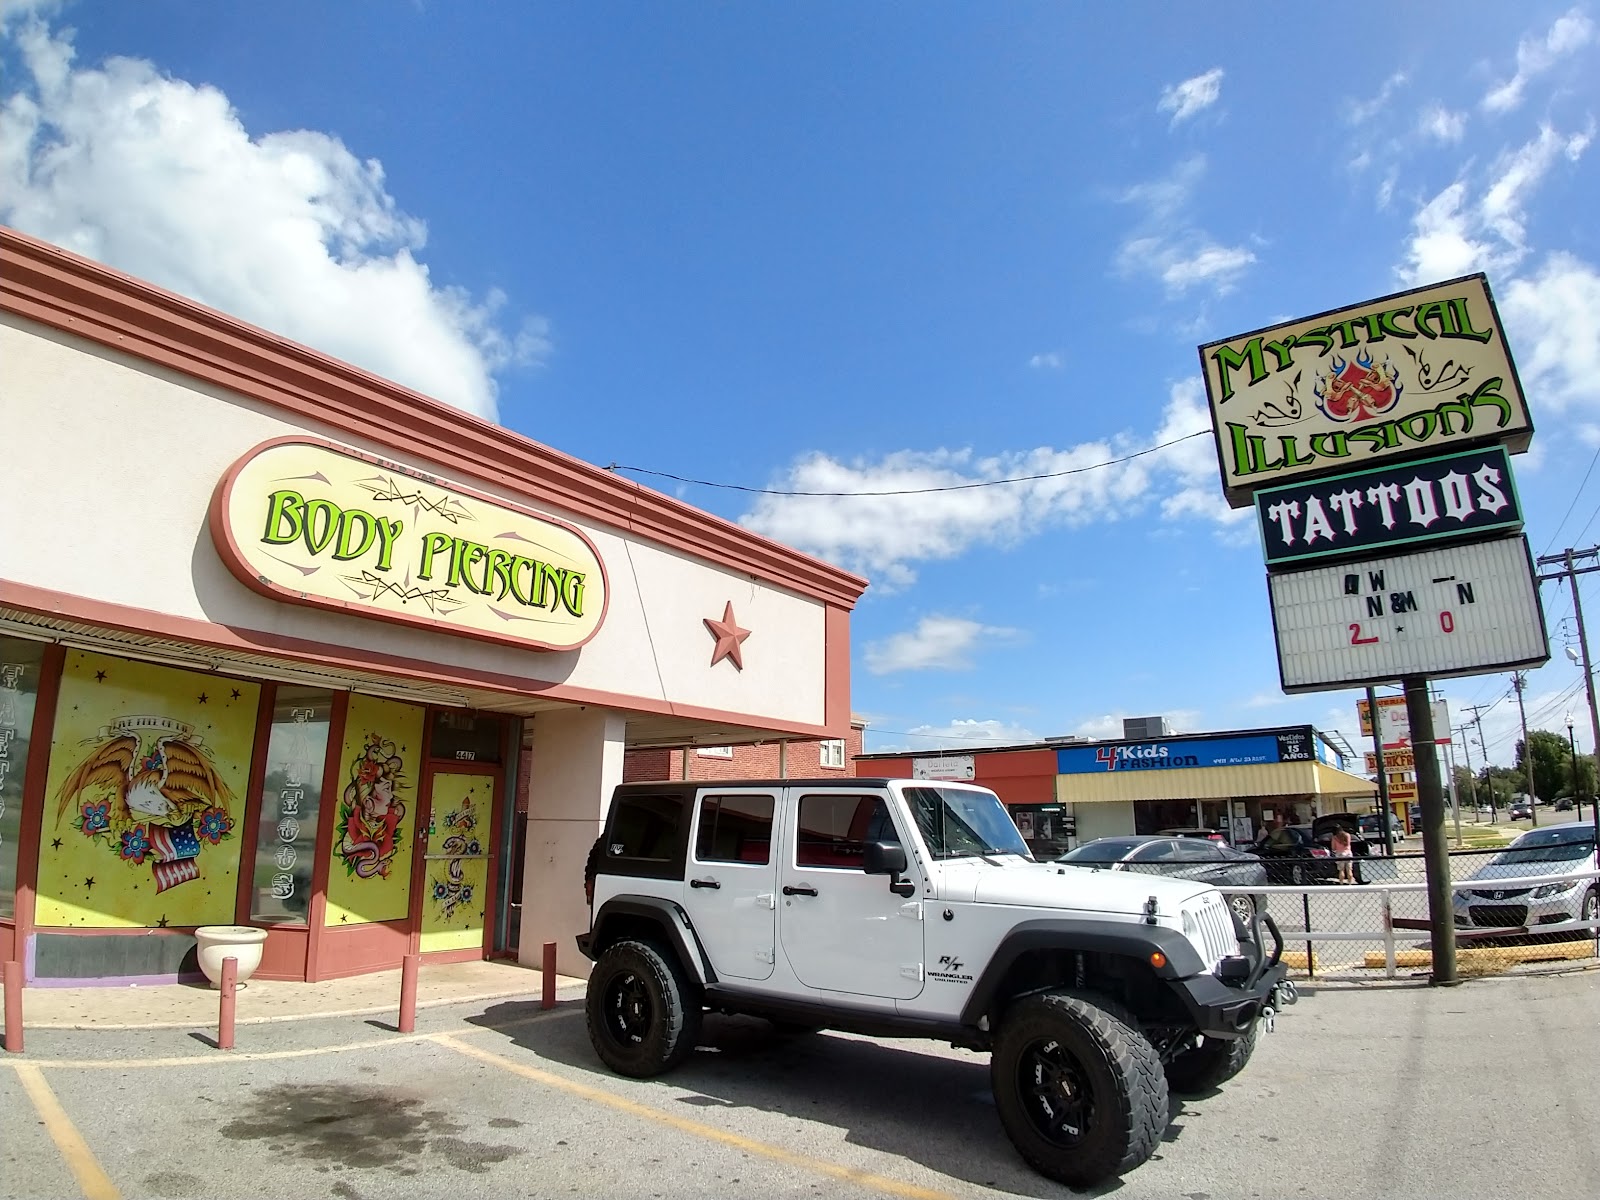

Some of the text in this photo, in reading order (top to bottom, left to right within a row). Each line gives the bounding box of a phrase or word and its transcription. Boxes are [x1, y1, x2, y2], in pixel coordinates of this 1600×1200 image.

[1212, 297, 1492, 404] MYSTICAL
[1225, 377, 1511, 476] ILLUSIONS
[1267, 462, 1509, 546] TATTOOS
[261, 490, 585, 618] BODY PIERCING
[1456, 582, 1475, 604] N
[1287, 744, 1300, 753] 15
[927, 971, 973, 981] WRANGLER
[938, 956, 964, 971] R/T
